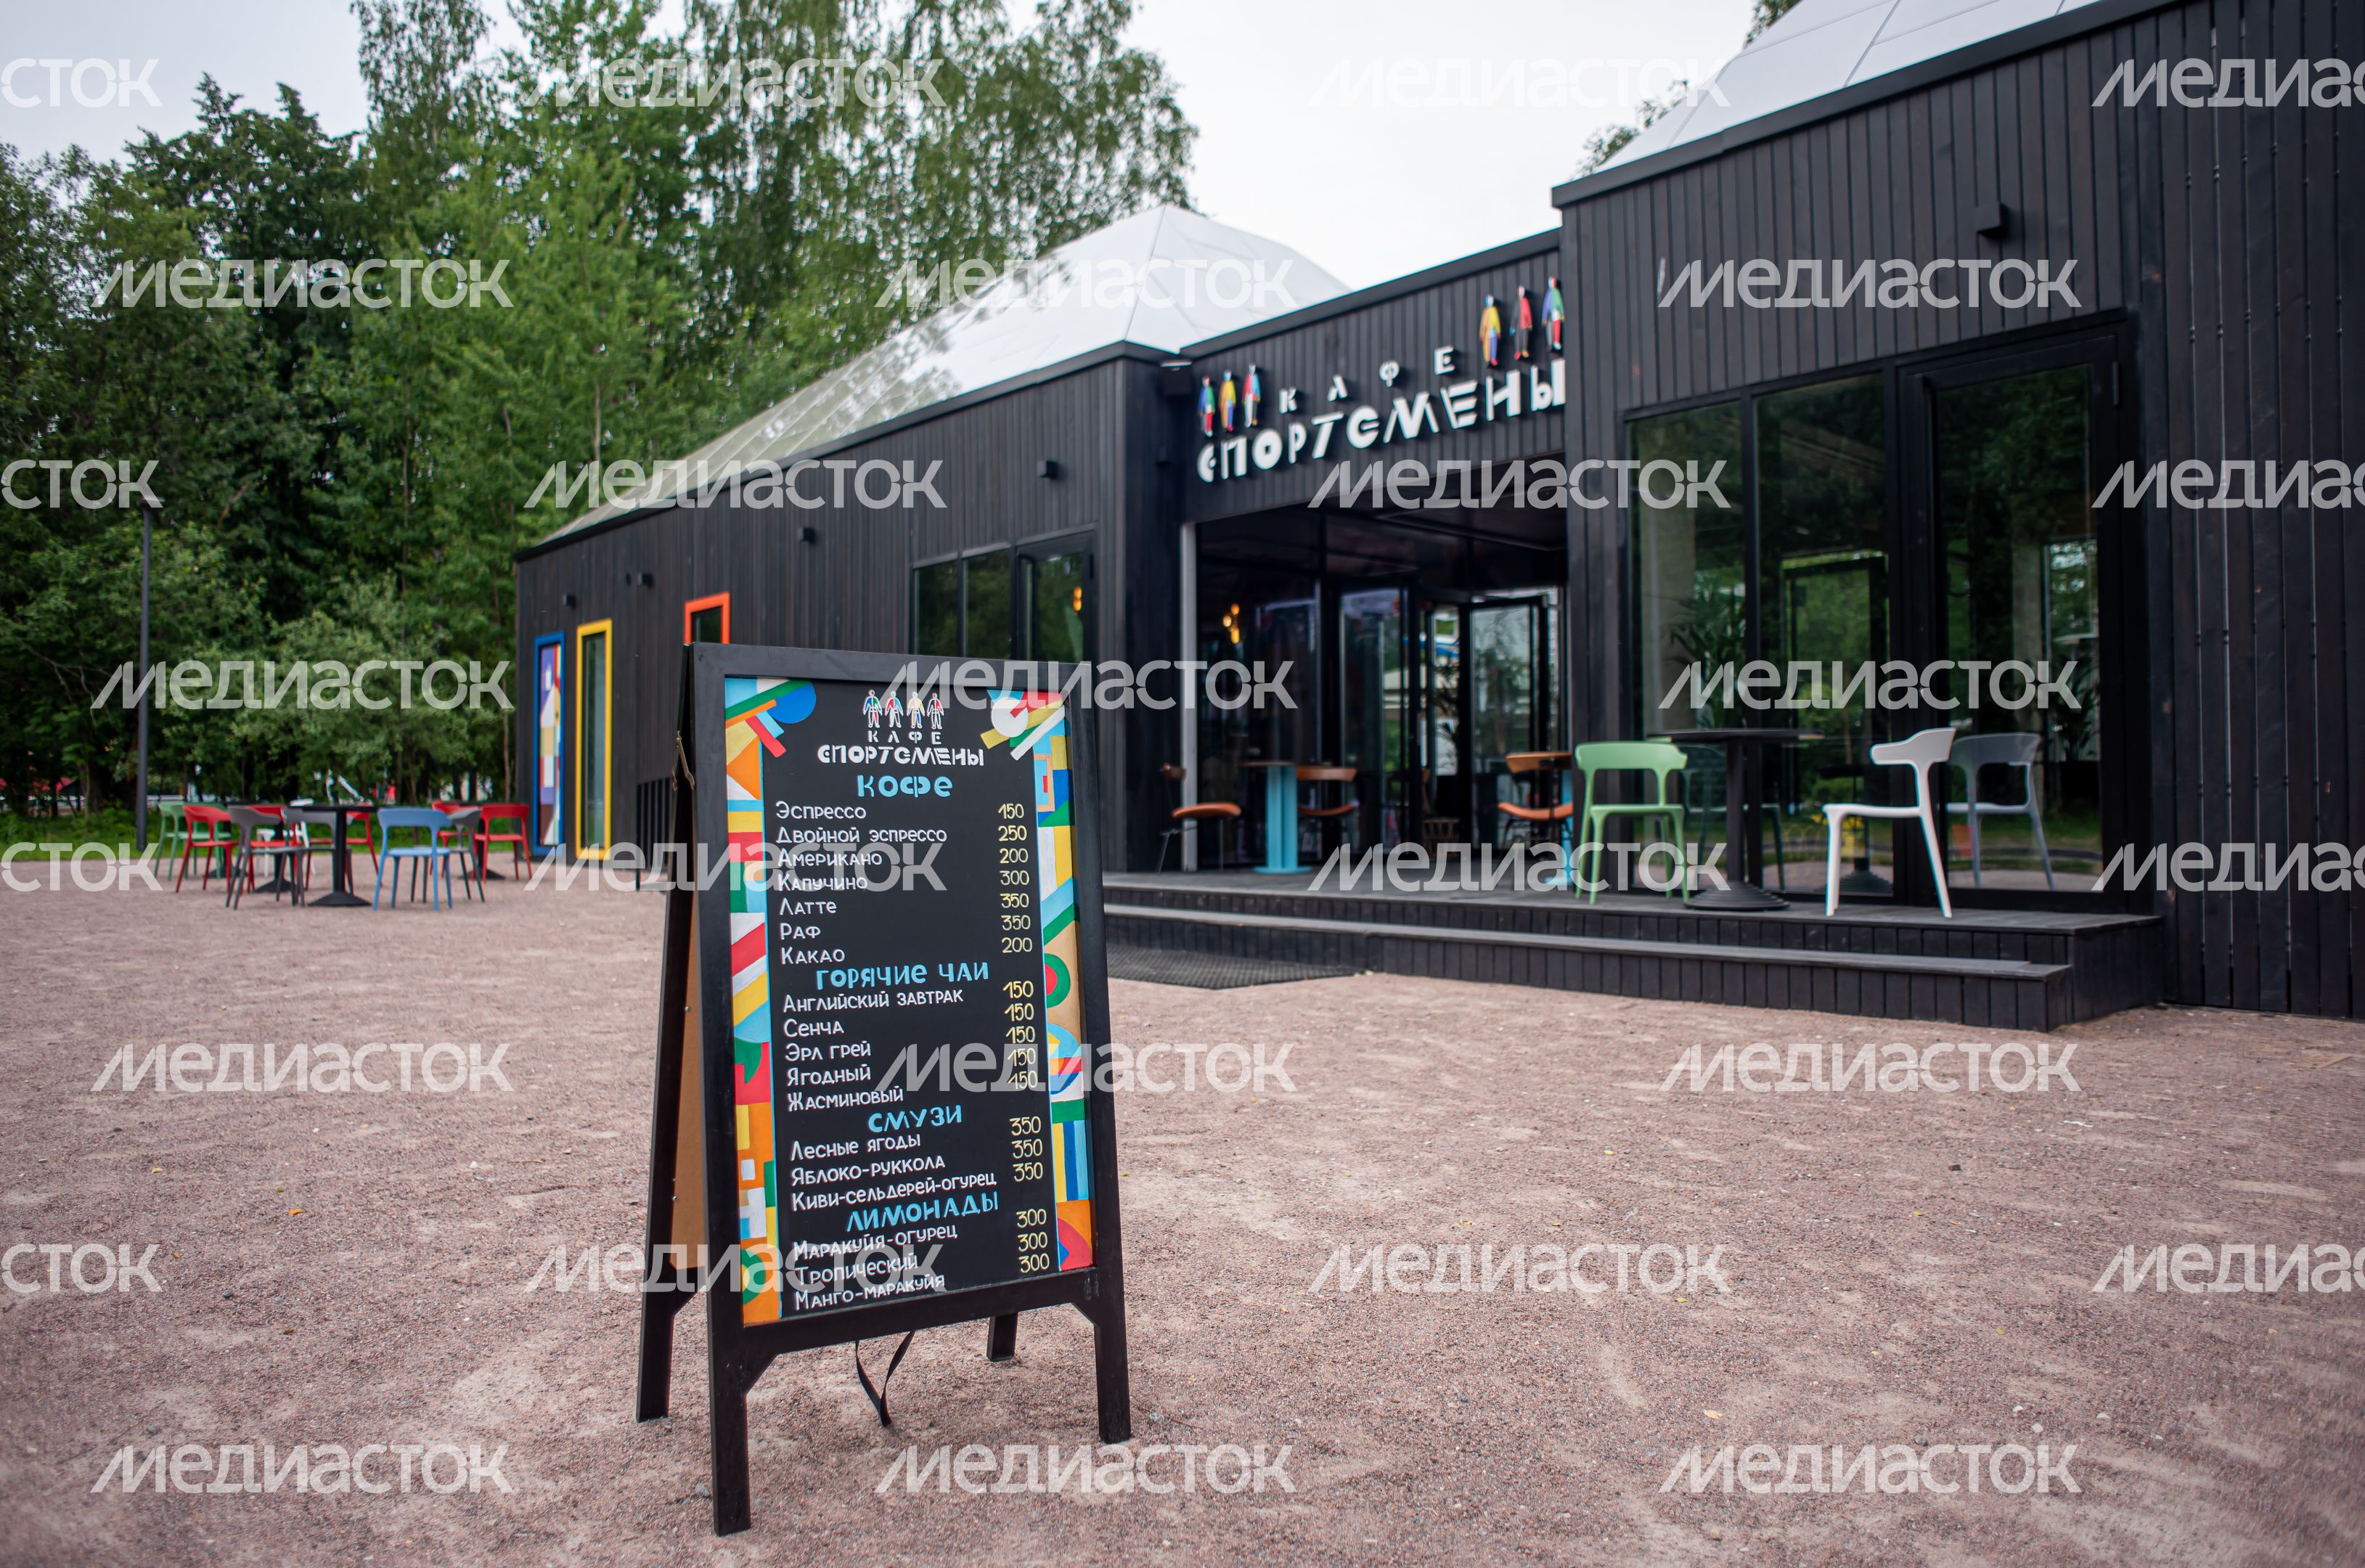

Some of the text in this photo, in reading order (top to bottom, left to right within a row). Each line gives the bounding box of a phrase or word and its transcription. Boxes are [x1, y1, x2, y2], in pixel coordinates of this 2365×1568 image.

[1279, 346, 1455, 415] КАФЕ
[1197, 358, 1567, 483] СПОРТСМЕНЫ
[868, 730, 941, 745] КАФЕ
[817, 744, 984, 767] СПОРТСМЕНЫ
[775, 801, 1024, 820] Эспрессо 150
[775, 825, 1027, 844] Двойной эспрессо 250
[777, 848, 1029, 867] Американо 200
[777, 870, 1030, 892] Капучино 300
[780, 893, 1029, 915] Латте 350
[780, 915, 1032, 940] Раф 350
[780, 937, 1032, 965] Какао 200
[938, 962, 989, 983] ЧАИ
[783, 981, 1034, 1013] Английский завтрак 150
[783, 1003, 1034, 1038] Сенча 150
[785, 1026, 1036, 1063] Эрл грей 150
[786, 1048, 1037, 1087] Ягодный 150
[788, 1070, 1038, 1112] Жасминовый 150
[868, 1104, 963, 1133] СМУЗИ
[791, 1116, 1041, 1161] Лесные ягоды 350
[791, 1138, 1043, 1187] Яблоко-руккола 350
[792, 1162, 1044, 1212] Киви-сельдерей-огурец 350
[846, 1191, 999, 1232] ЛИМОНАДЫ
[793, 1208, 1047, 1262] Маракуйя-огурец 300
[794, 1232, 1048, 1286] Тропический 300
[795, 1254, 1050, 1310] Манго-маракуйя 300
